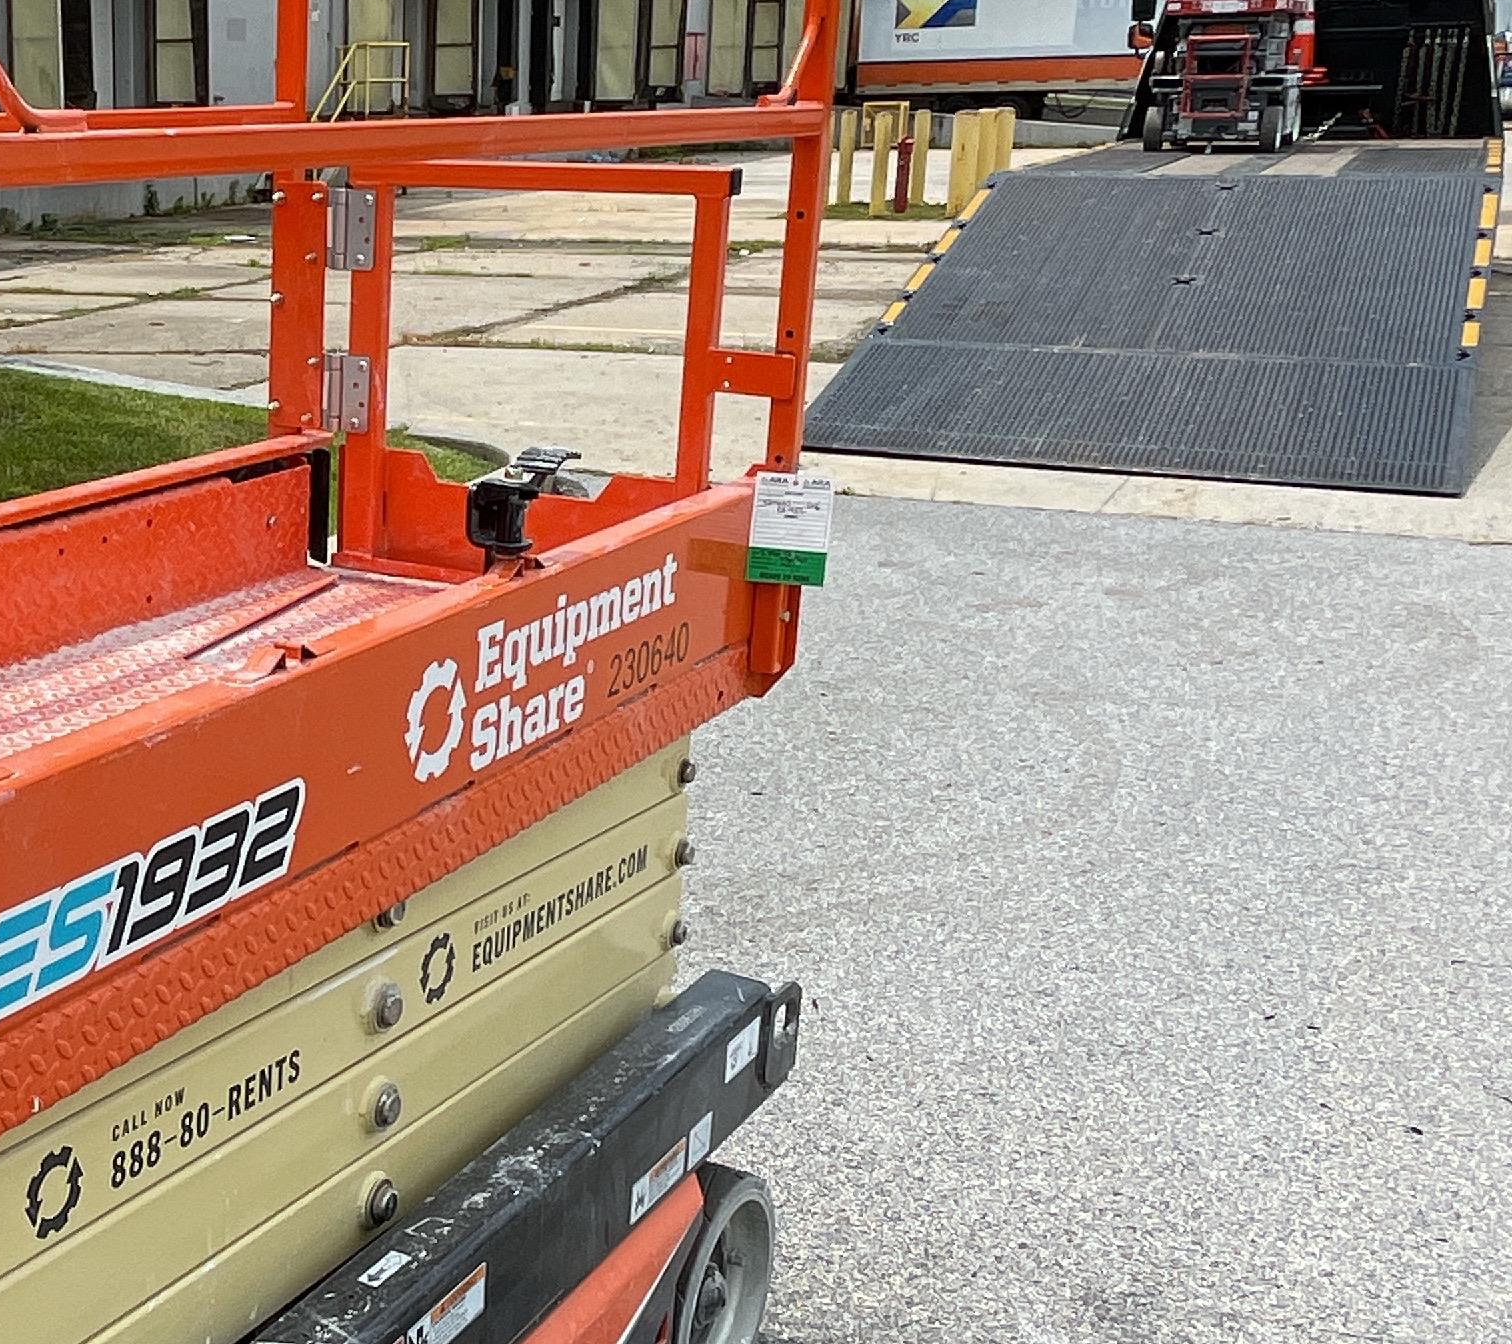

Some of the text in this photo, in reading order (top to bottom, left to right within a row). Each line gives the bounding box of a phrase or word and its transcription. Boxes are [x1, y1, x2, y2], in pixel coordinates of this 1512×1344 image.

[895, 33, 920, 44] YRC
[474, 552, 679, 693] Equipment
[606, 621, 691, 699] 230640
[469, 674, 586, 773] Share
[471, 843, 649, 973] EQUIPMENTSHARE.COM
[110, 1049, 301, 1189] 888-80-RENTS
[112, 1086, 186, 1142] CALL NOW
